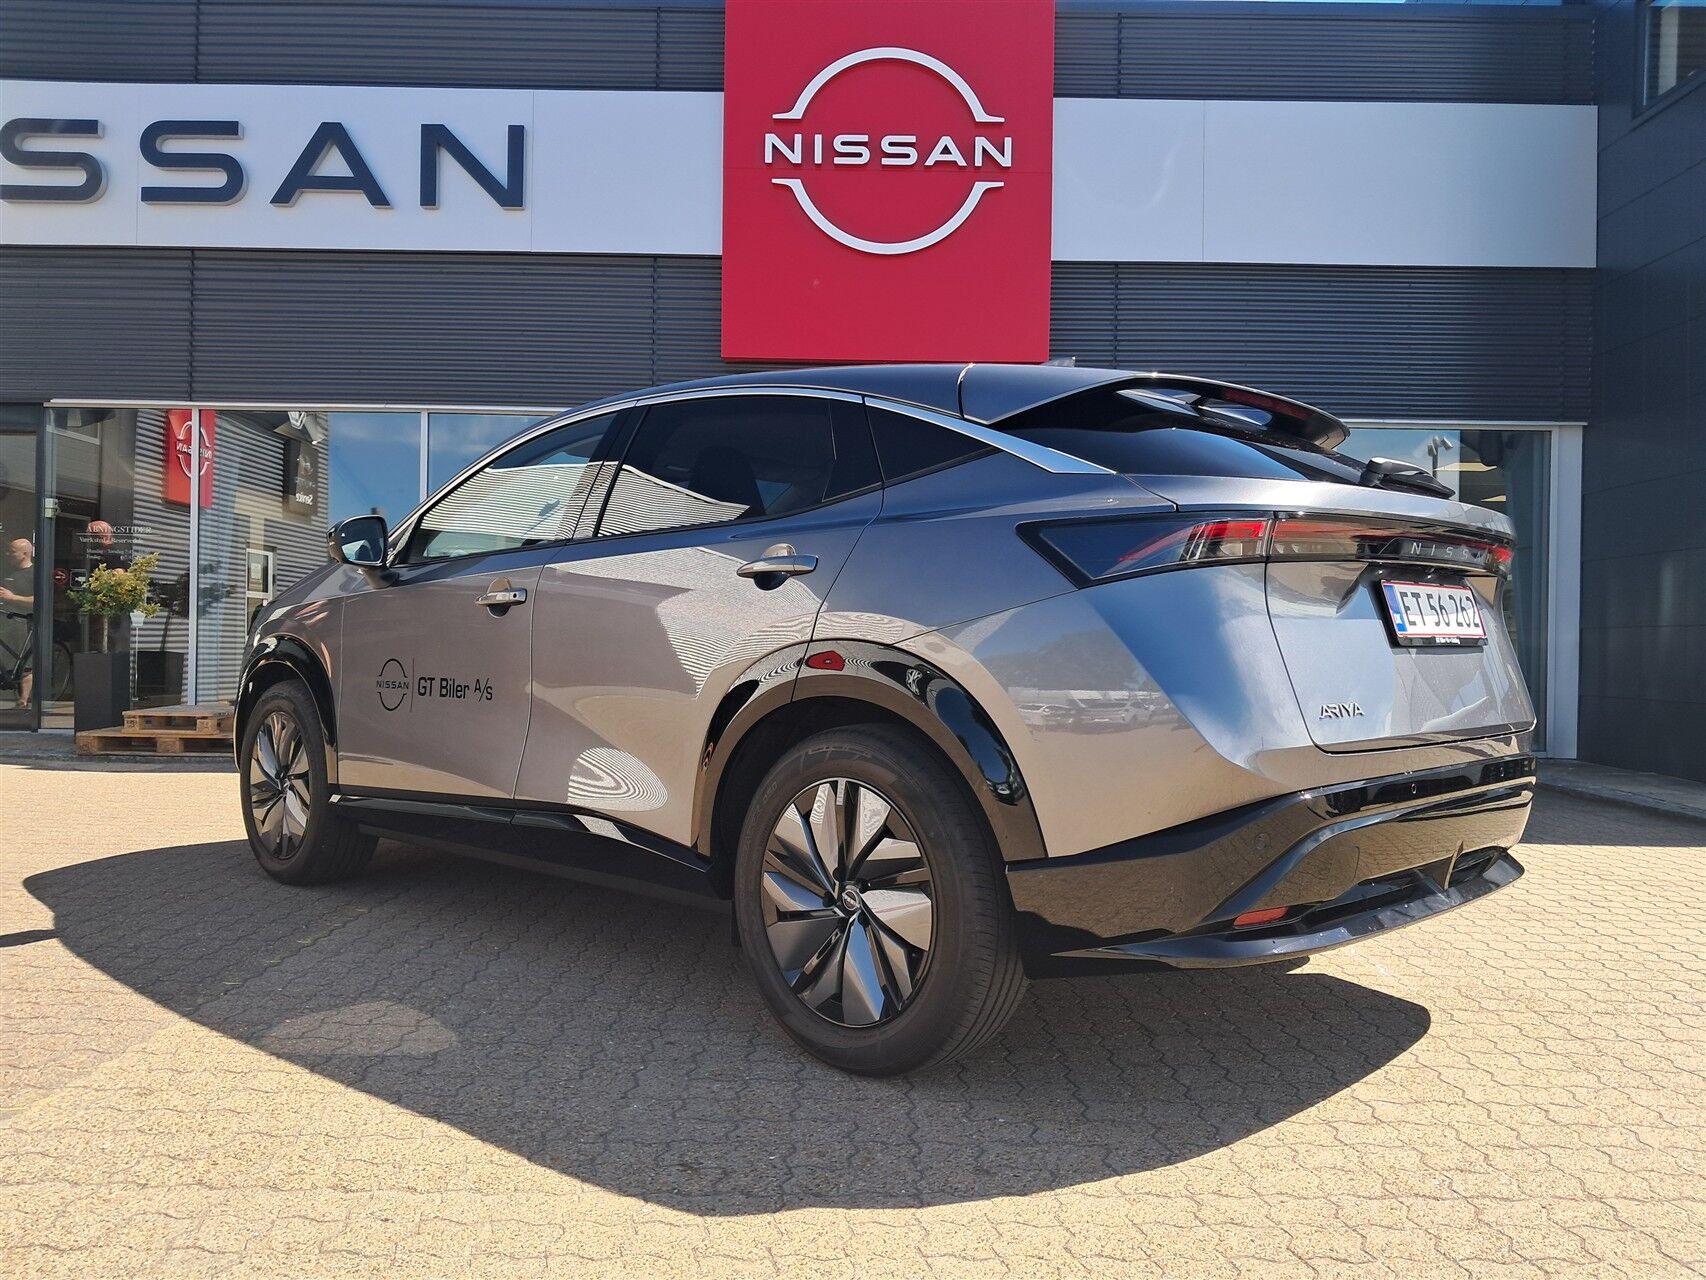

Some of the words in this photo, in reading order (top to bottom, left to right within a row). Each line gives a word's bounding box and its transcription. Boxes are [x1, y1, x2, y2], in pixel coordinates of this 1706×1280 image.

[764, 133, 1012, 167] NISSAN
[1400, 592, 1426, 626] ET
[1426, 593, 1450, 627] 56
[1448, 594, 1480, 628] 262
[376, 680, 409, 690] NISSAN
[417, 677, 435, 697] GT
[439, 678, 470, 699] Biler
[1319, 702, 1365, 719] ARIYA
